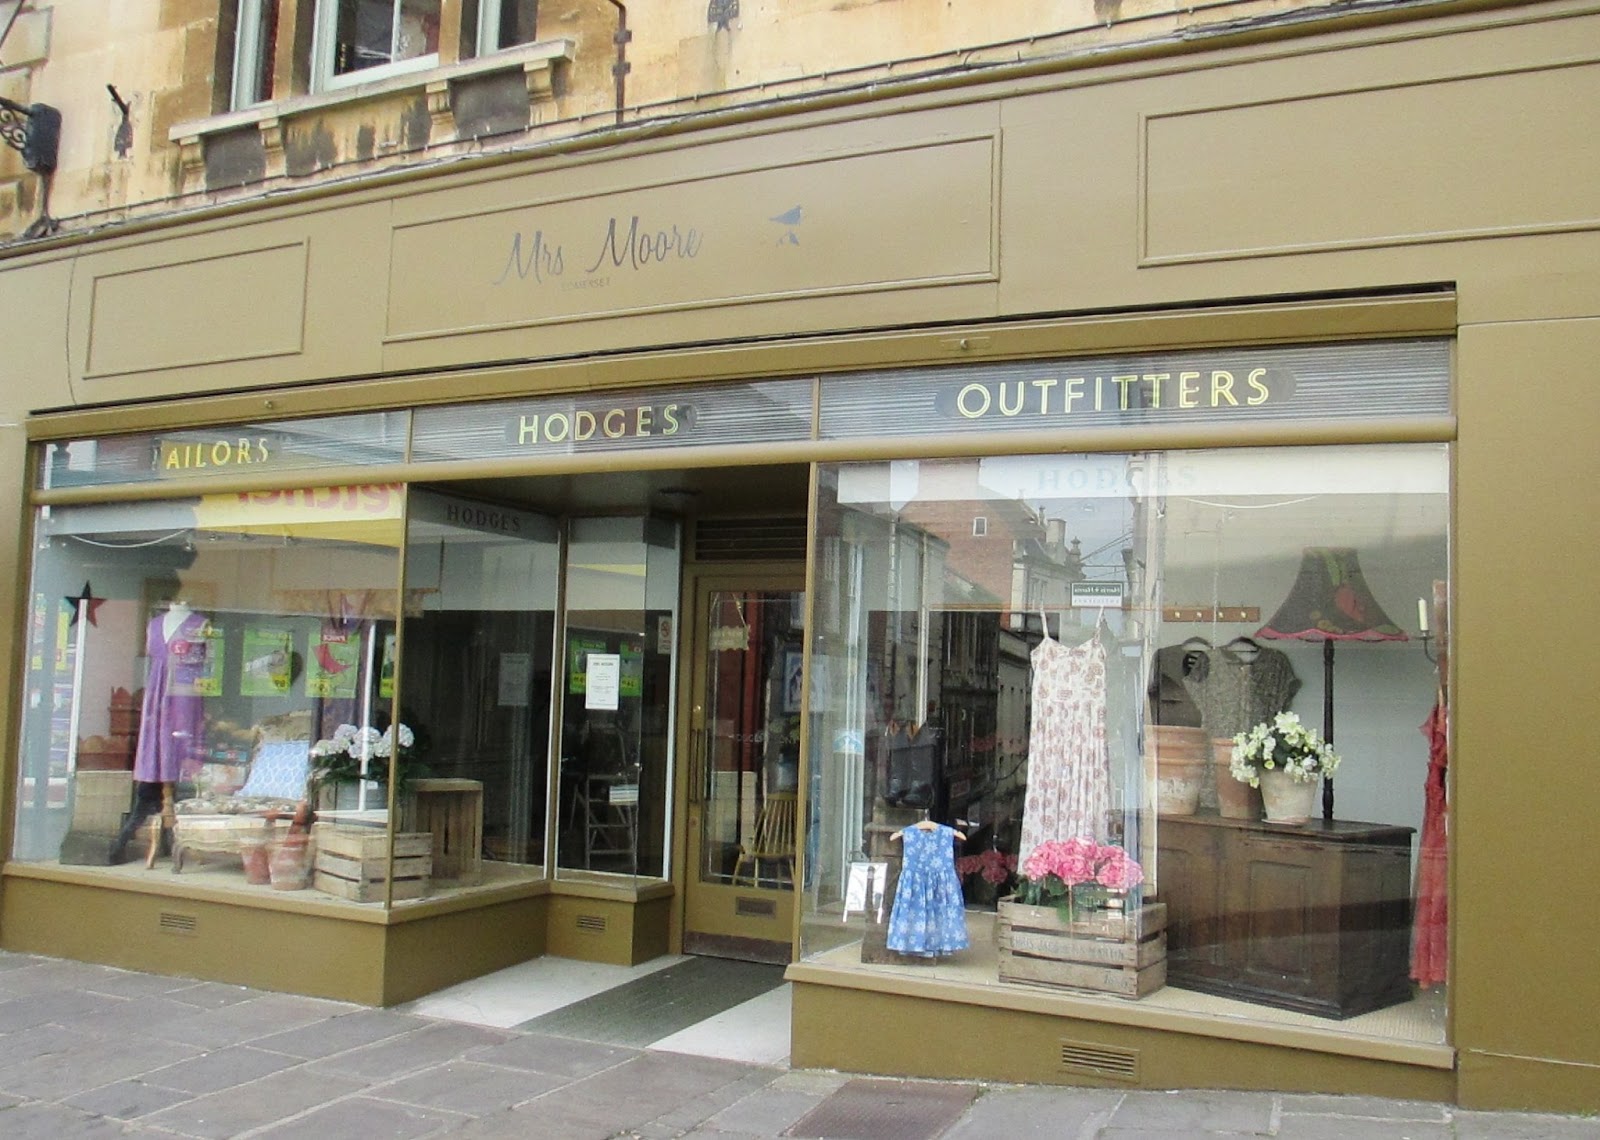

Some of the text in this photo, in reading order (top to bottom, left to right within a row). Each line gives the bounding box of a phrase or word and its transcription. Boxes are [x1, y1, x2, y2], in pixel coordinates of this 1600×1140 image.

[493, 215, 704, 285] Mrs Moore
[956, 367, 1270, 419] OUTFITTERS
[518, 403, 680, 445] HODGES
[447, 503, 520, 532] HODGES
